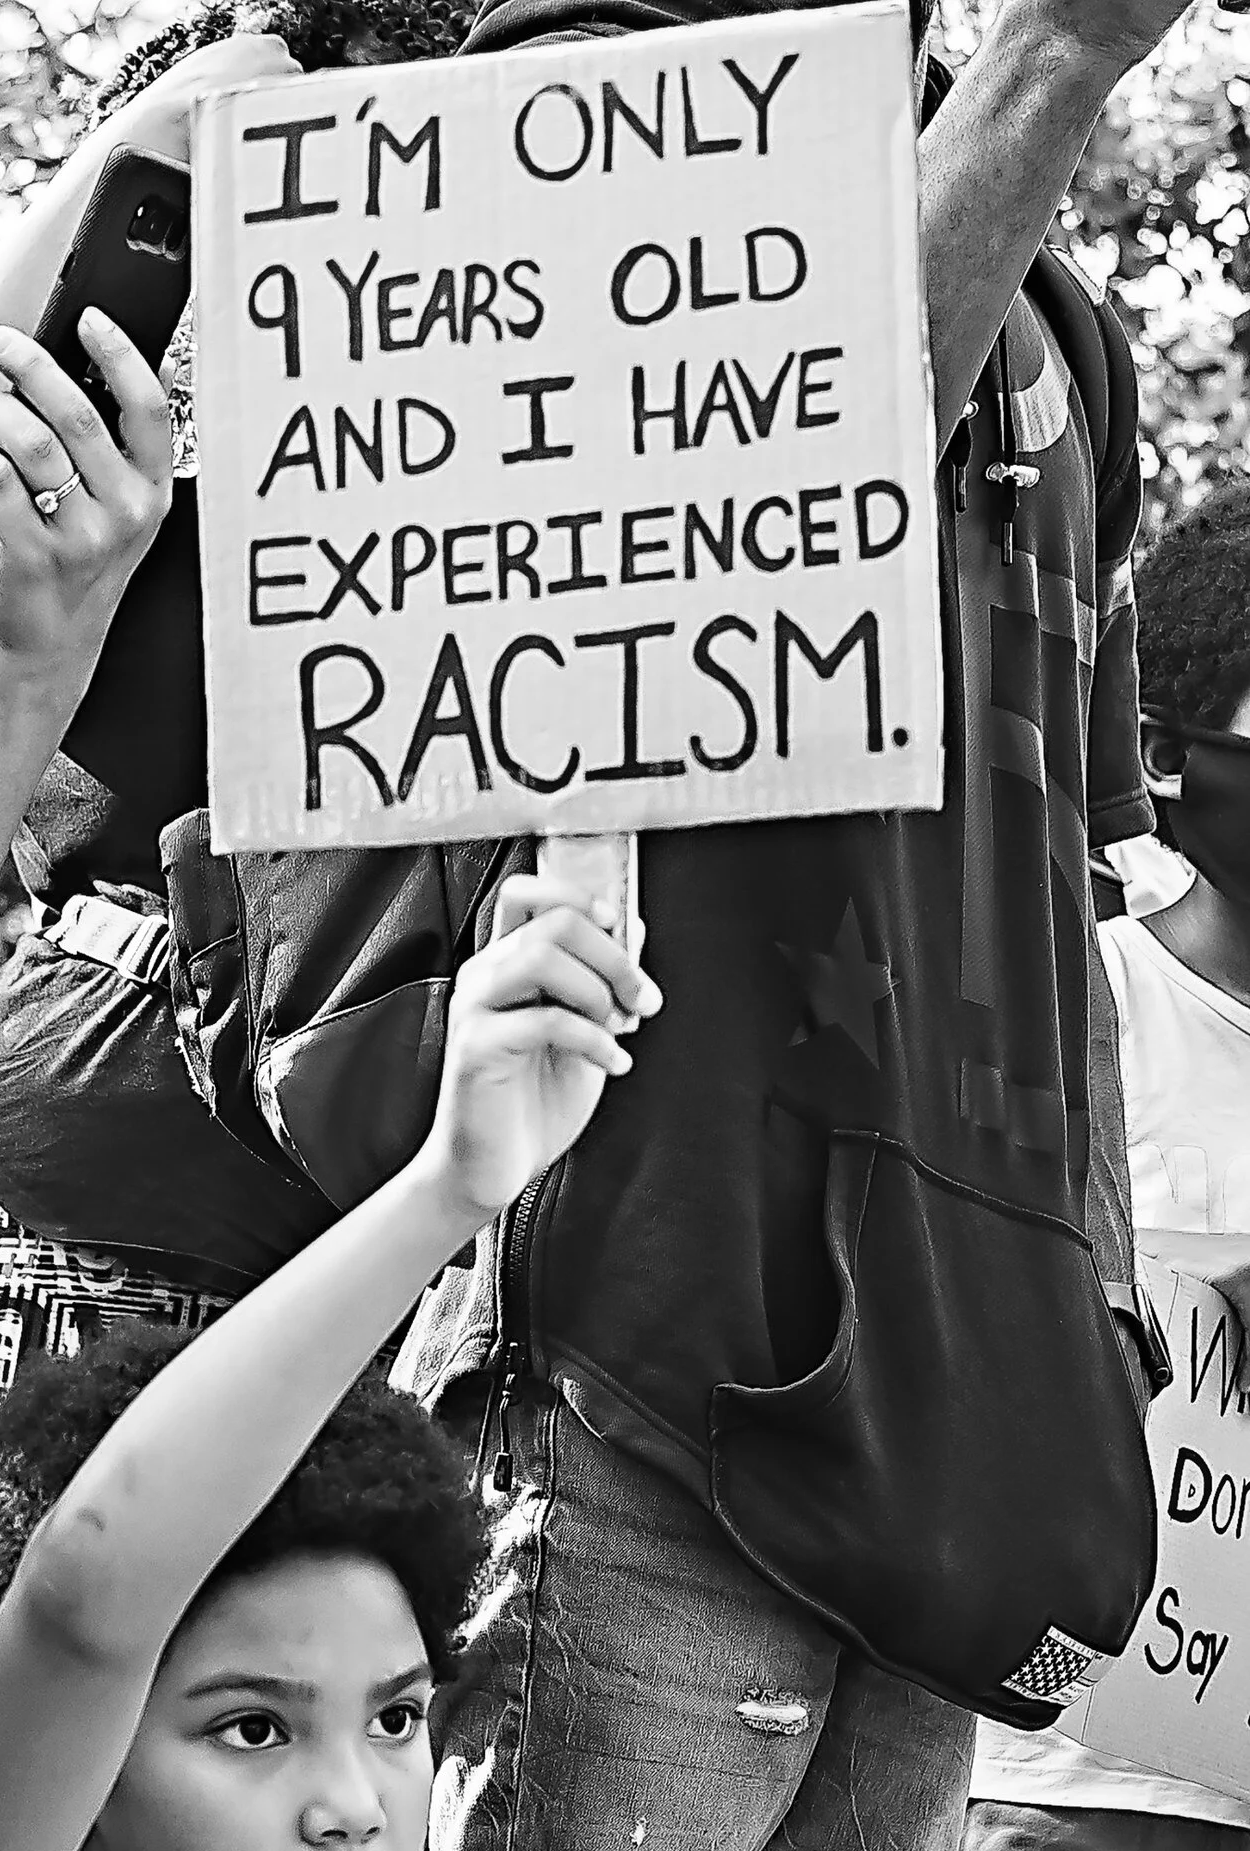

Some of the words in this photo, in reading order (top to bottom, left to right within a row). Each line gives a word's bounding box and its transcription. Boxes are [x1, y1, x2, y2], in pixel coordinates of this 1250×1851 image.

[243, 97, 441, 224] I'M
[514, 53, 799, 181] ONLY
[248, 264, 301, 378] 9
[327, 251, 544, 362] YEARS
[610, 227, 808, 326] OLD
[257, 398, 456, 498] AND
[502, 375, 575, 465] I
[632, 346, 844, 456] HAVE
[249, 479, 910, 626] EXPERIENCED
[298, 610, 910, 811] RACISM.
[1145, 1587, 1229, 1705] Say
